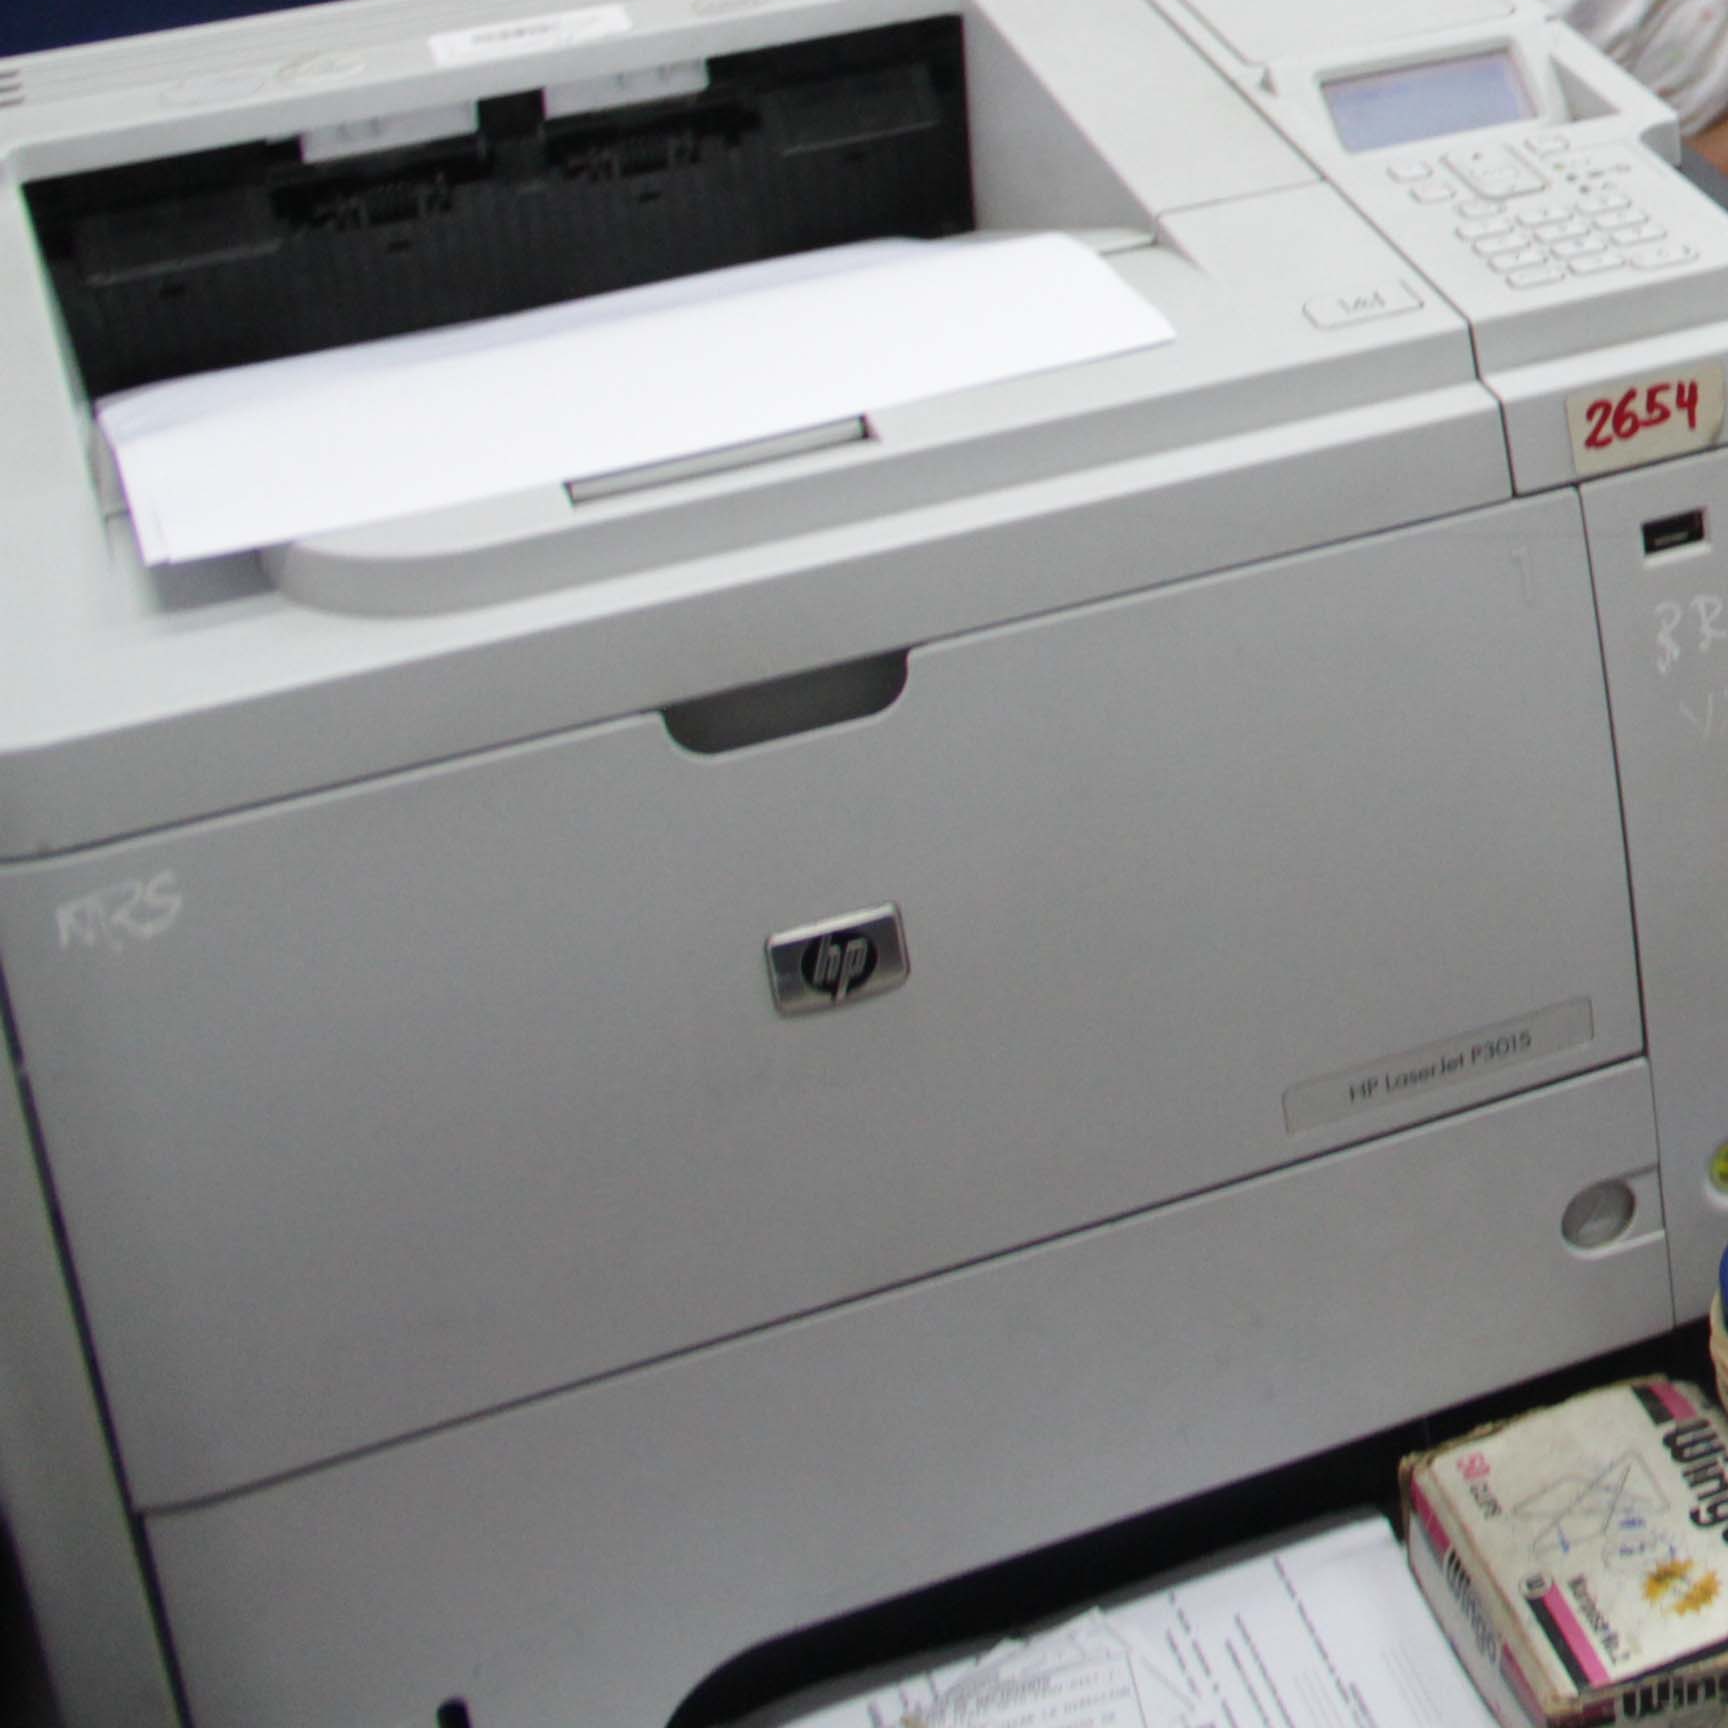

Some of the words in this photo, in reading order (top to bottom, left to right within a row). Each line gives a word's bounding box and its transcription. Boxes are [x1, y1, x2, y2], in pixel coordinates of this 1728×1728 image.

[1584, 380, 1699, 449] 2654
[812, 932, 868, 1008] hp
[1349, 1078, 1379, 1104] HP
[1385, 1053, 1464, 1093] LaserJet
[1471, 1029, 1533, 1065] P3015
